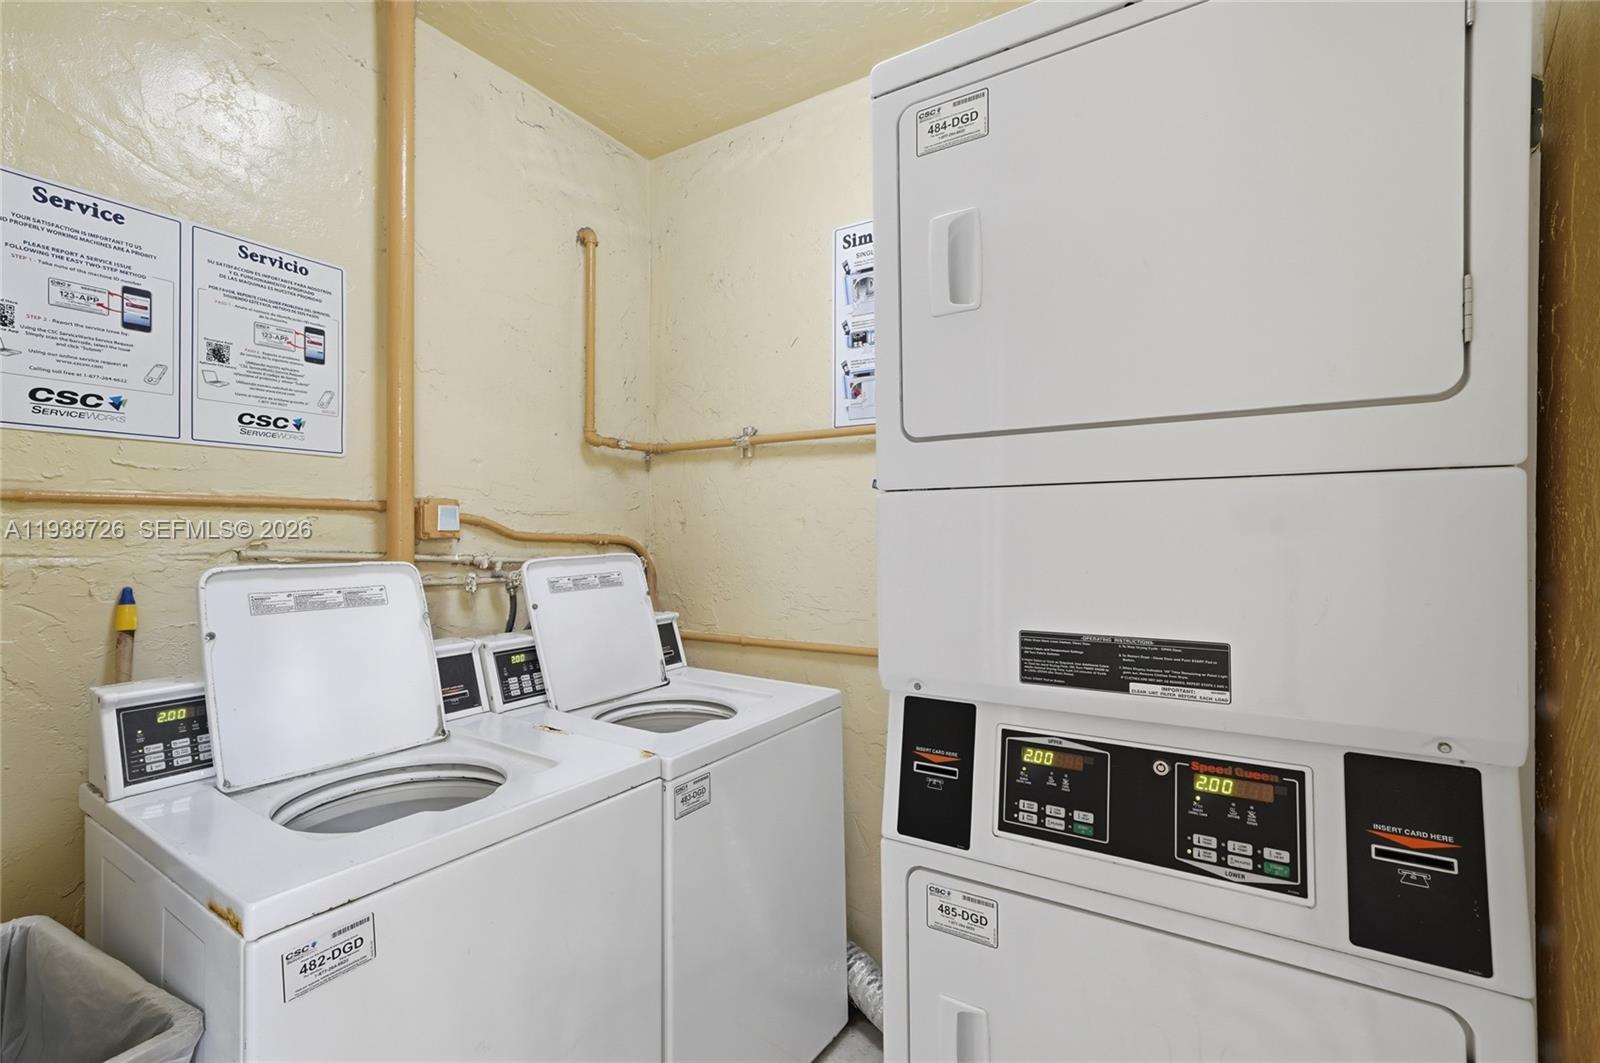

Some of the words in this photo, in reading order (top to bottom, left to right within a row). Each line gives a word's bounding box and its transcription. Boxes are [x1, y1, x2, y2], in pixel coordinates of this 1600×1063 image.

[928, 111, 978, 134] 484-DGD
[32, 186, 125, 224] Service
[10, 211, 30, 221] YOUR
[32, 217, 79, 234] SATISFACTION
[88, 231, 123, 245] IMPORTANT
[9, 217, 44, 232] PROPERLY
[46, 227, 77, 240] WORKING
[79, 235, 111, 248] MACHINES
[112, 244, 123, 252] ARE
[131, 248, 156, 260] PRIORITY
[842, 233, 873, 250] Sim
[4, 241, 49, 257] FOLLOWING
[51, 252, 63, 260] THE
[65, 256, 83, 265] EASY
[85, 260, 117, 273] TWO-STEP
[120, 268, 146, 279] METHOD
[22, 239, 49, 251] PLEASE
[51, 246, 77, 257] REPORT
[86, 254, 112, 265] SERVICE
[113, 261, 131, 270] ISSUE
[238, 245, 308, 276] Servicio
[59, 289, 99, 303] 123-APP
[26, 313, 41, 321] STEP
[28, 387, 104, 408] CSC
[237, 412, 290, 430] CSC
[1160, 686, 1195, 694] IMPORTANT:
[157, 708, 186, 723] 2.00
[1023, 748, 1054, 766] 2.00
[1191, 762, 1232, 775] Speed
[1234, 768, 1280, 783] Queen
[1195, 776, 1233, 794] 2.00
[1373, 824, 1402, 834] INSERT
[1404, 829, 1428, 838] CARD
[1430, 834, 1455, 843] HERE
[1224, 870, 1246, 880] LOWER
[938, 904, 988, 926] 485-DGD
[285, 944, 310, 960] CSC
[299, 936, 364, 974] 482-DGD
